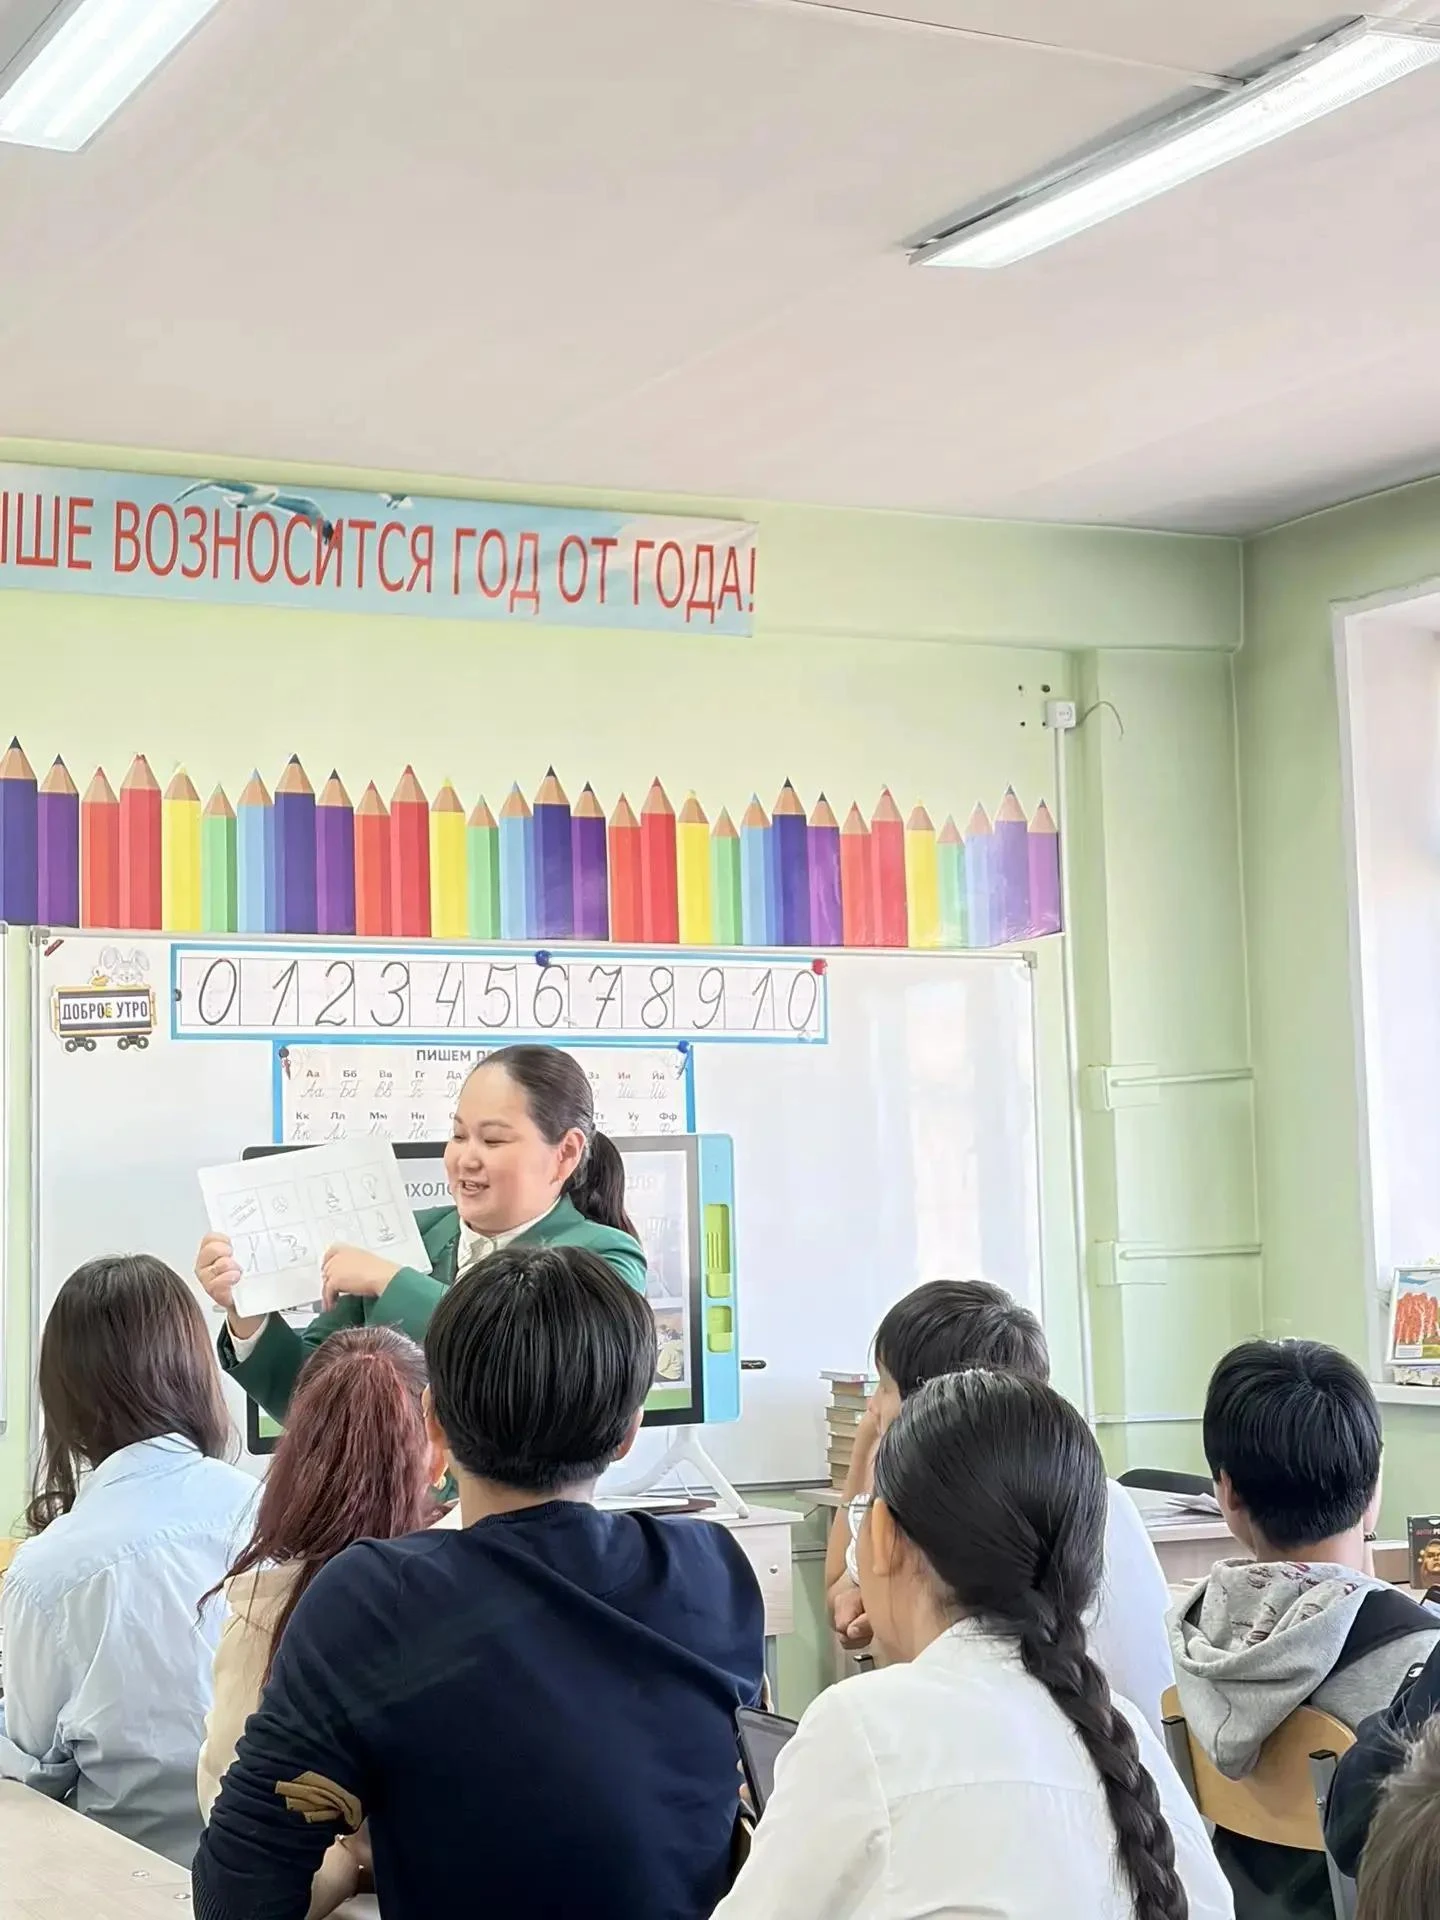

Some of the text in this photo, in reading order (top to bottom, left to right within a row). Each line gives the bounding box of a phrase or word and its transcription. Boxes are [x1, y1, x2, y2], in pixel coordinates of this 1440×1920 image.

[113, 500, 434, 593] ВОЗНОСИТСЯ
[453, 528, 540, 615] ГОД
[557, 534, 618, 604] ОТ
[634, 540, 756, 624] ГОДА!
[199, 958, 237, 1025] 0
[272, 959, 298, 1026] 1
[315, 961, 354, 1026] 2
[371, 962, 410, 1027] 3
[436, 962, 462, 1027] 4
[477, 963, 517, 1028] 5
[533, 964, 569, 1028] 6
[588, 965, 622, 1028] 7
[641, 967, 674, 1028] 8
[692, 967, 724, 1029] 9
[62, 1000, 148, 1020] ДОБРОЕ УТРО
[416, 1049, 471, 1061] ПИШЕМ
[306, 1070, 320, 1078] Аа
[343, 1070, 358, 1078] Бб
[415, 1070, 426, 1078] Гг
[446, 1071, 462, 1080] Дд
[296, 1112, 310, 1120] Кк
[330, 1112, 346, 1120] Лл
[369, 1112, 388, 1120] Мм
[411, 1112, 425, 1120] Нн
[628, 1111, 640, 1121] Уу
[659, 1112, 678, 1121] Фф
